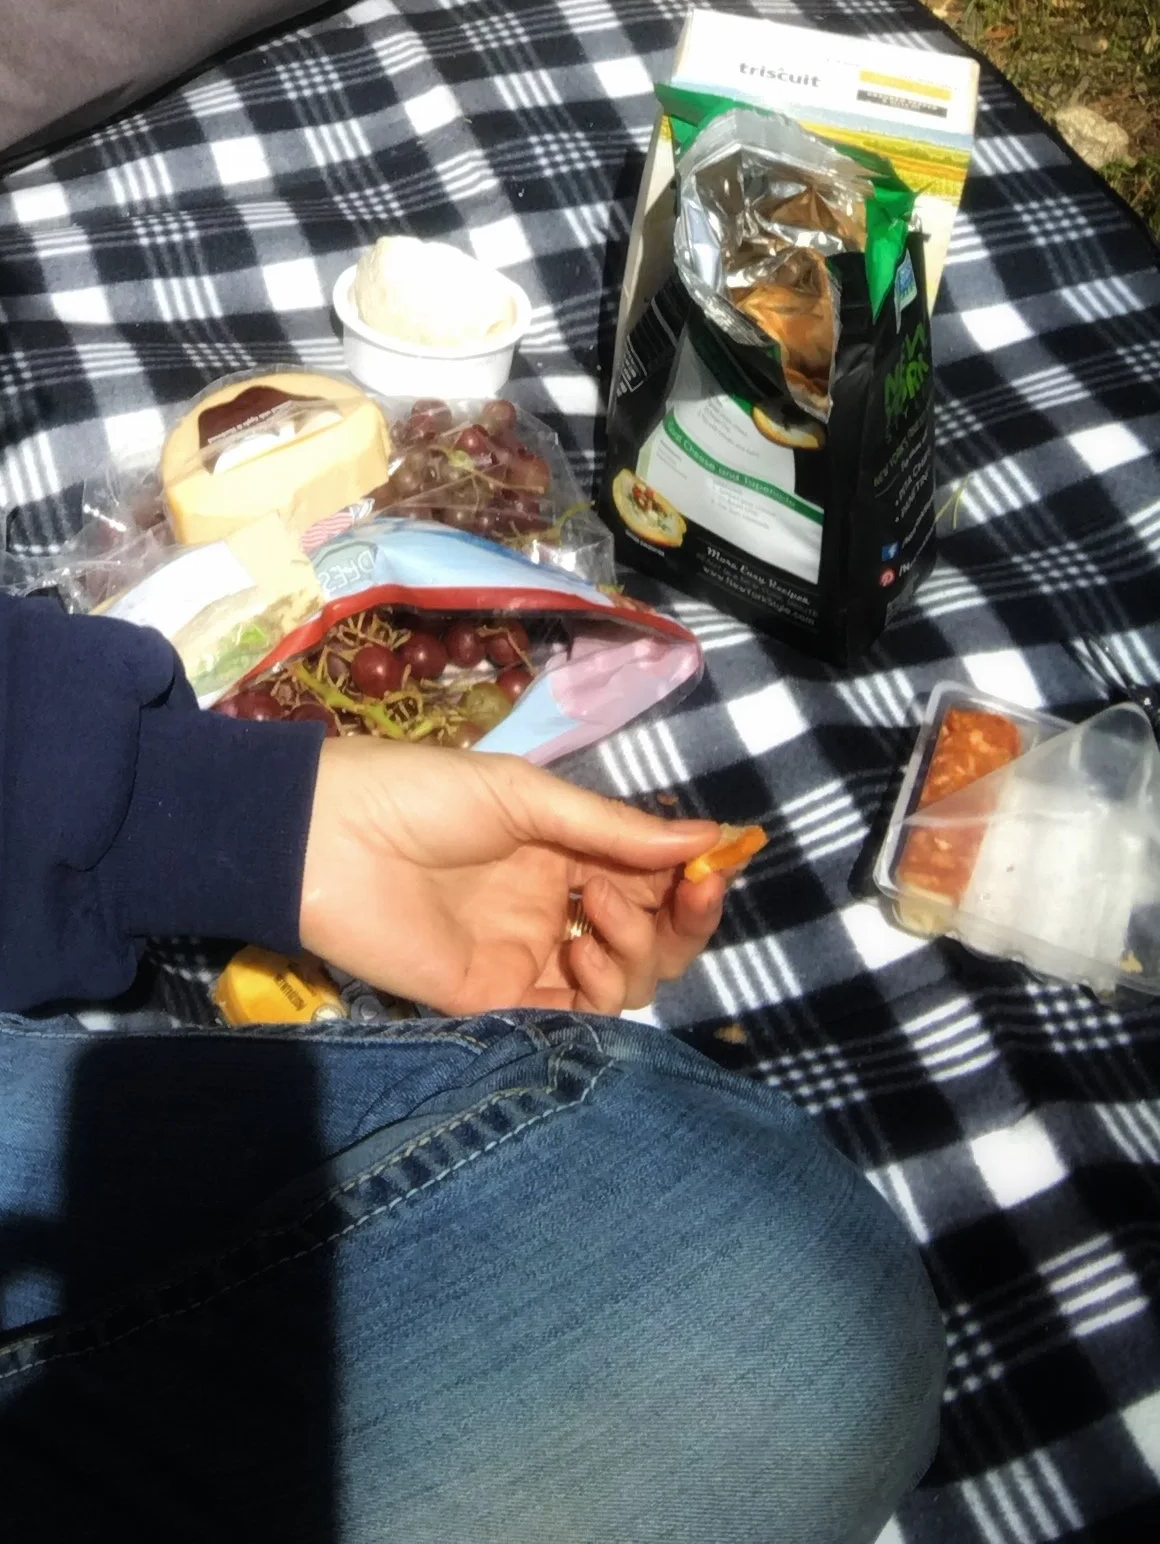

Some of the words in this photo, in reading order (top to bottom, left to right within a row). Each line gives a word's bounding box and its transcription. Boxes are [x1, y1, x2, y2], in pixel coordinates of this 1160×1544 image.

[739, 62, 821, 88] triscuit
[706, 545, 739, 571] More
[739, 563, 767, 585] Easy
